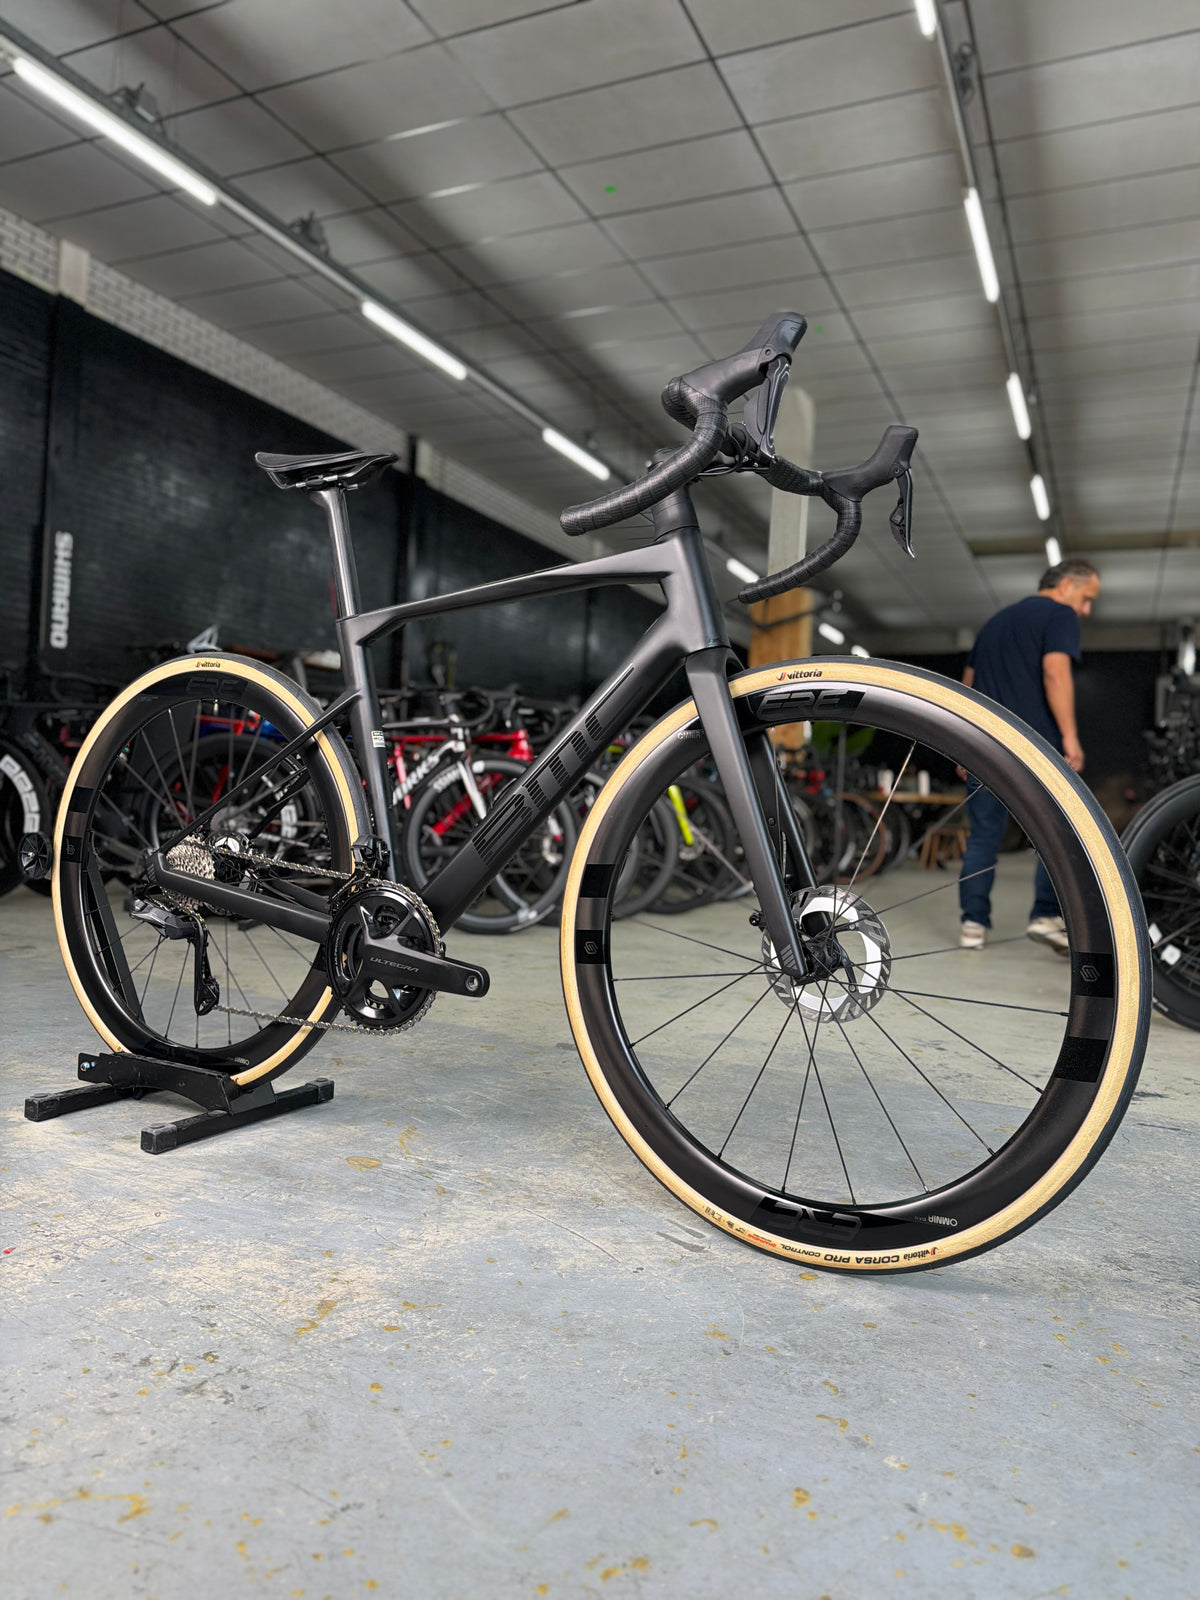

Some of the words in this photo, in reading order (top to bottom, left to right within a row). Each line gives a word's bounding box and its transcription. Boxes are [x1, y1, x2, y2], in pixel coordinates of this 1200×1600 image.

[50, 531, 73, 649] SHIMANO
[787, 669, 823, 680] vittoria
[757, 688, 850, 719] ERE
[370, 957, 420, 973] ULTEGRA
[928, 1214, 958, 1227] OMNIA
[780, 1243, 821, 1257] CONTROL
[903, 1250, 930, 1262] vittoria
[824, 1253, 851, 1264] PRO
[855, 1254, 900, 1264] CORSA
